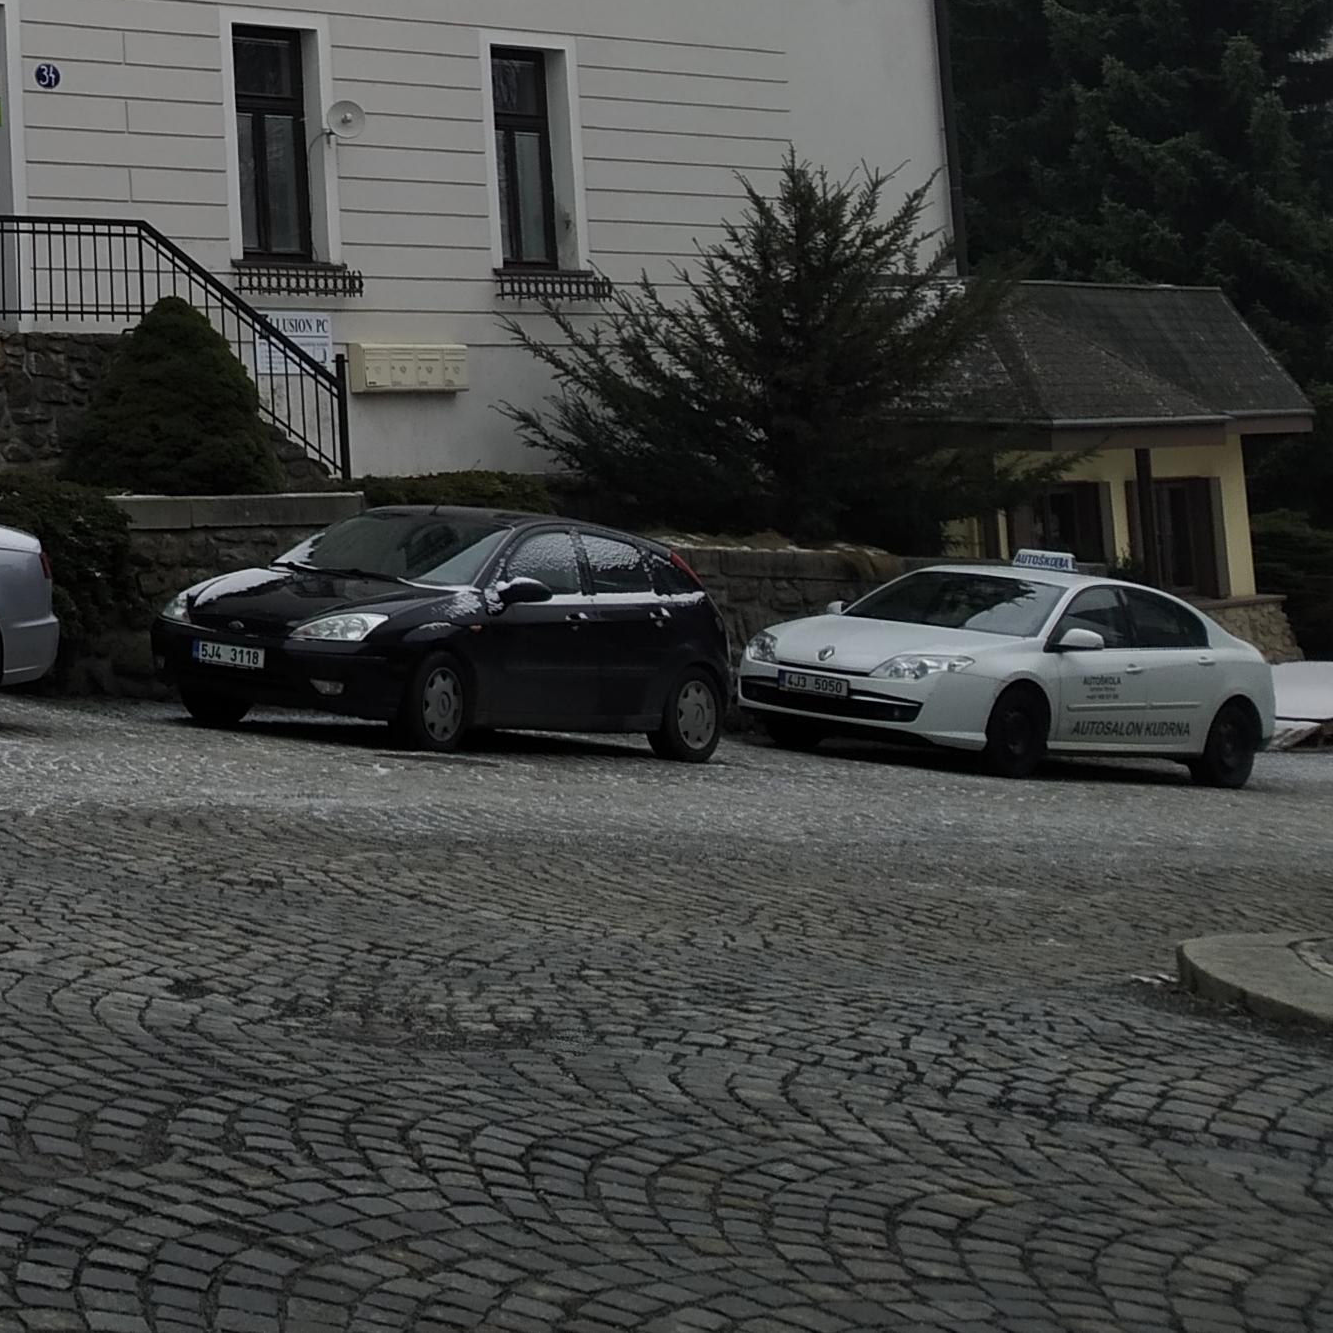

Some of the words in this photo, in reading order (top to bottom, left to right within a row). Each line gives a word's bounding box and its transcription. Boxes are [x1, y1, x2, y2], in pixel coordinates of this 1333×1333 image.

[39, 64, 56, 87] 34
[316, 318, 329, 334] PC
[201, 642, 222, 660] 5J4
[230, 647, 260, 665] 3118
[787, 674, 807, 688] 4J3
[814, 678, 843, 693] 5050
[1082, 674, 1122, 686] AUTOŠKOLA
[1071, 720, 1143, 736] AUTOSALON
[1144, 720, 1191, 738] KUDRNA
